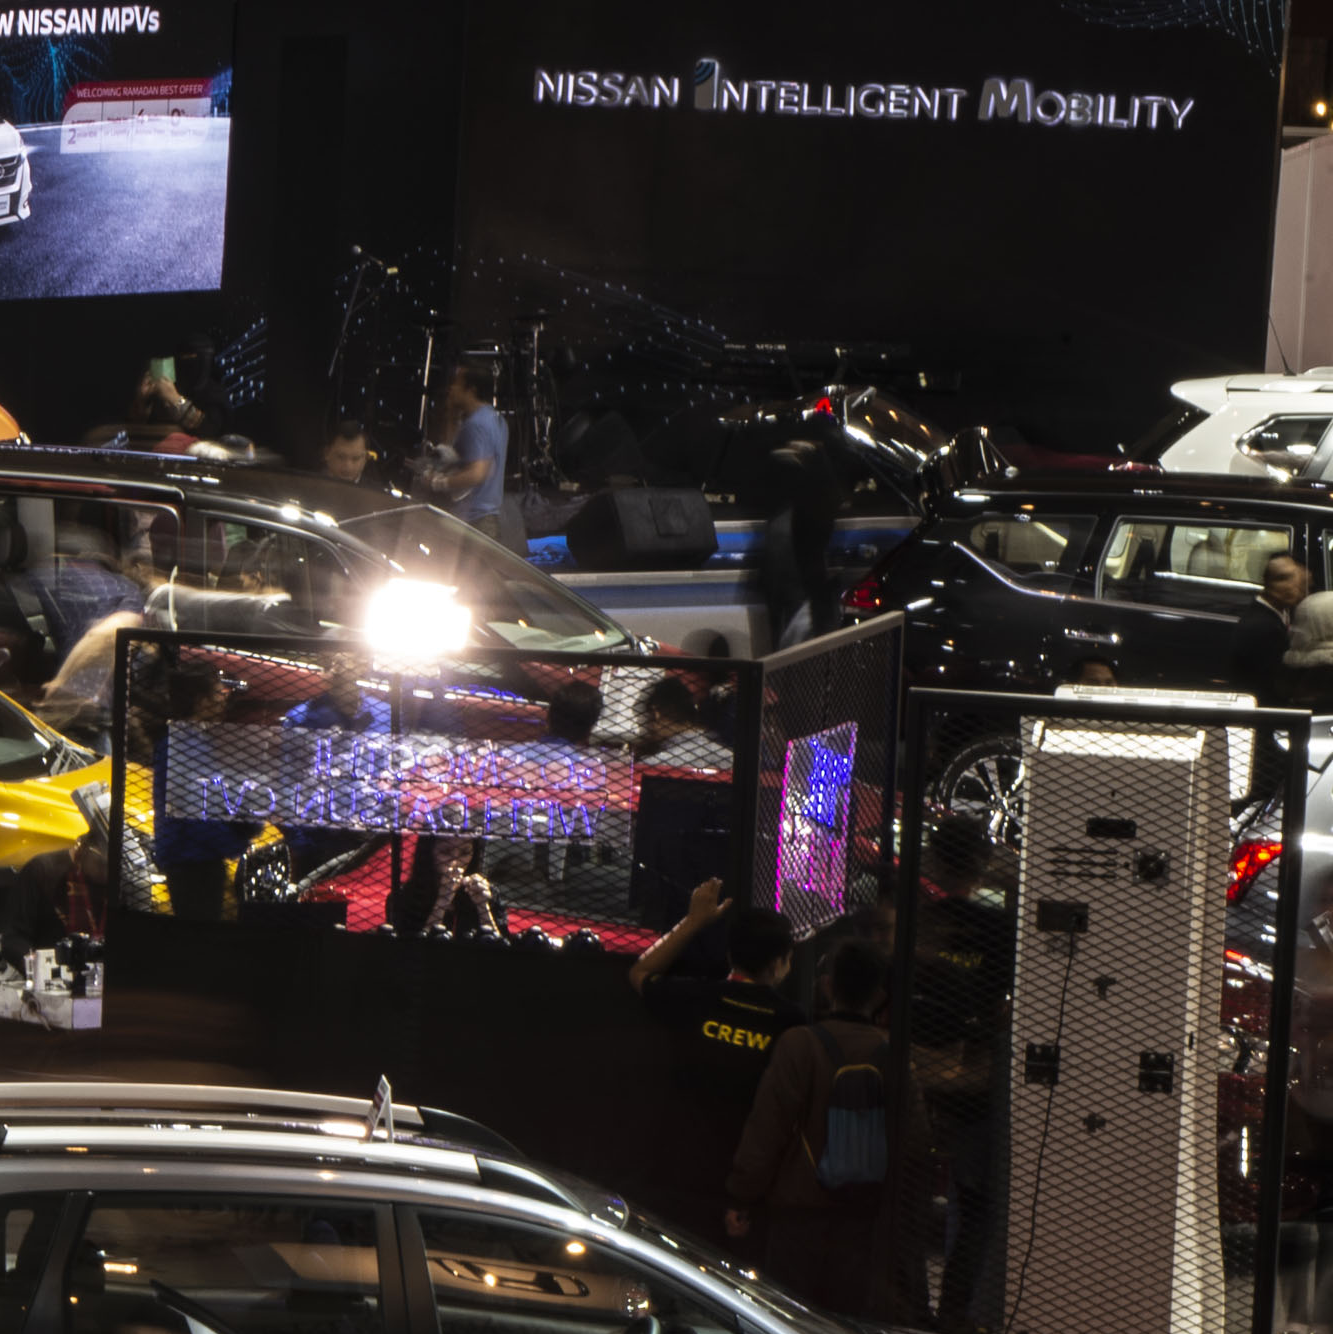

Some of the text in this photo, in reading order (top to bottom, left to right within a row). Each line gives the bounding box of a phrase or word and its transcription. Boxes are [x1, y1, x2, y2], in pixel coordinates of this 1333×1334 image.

[18, 8, 97, 37] NISSAN
[101, 6, 160, 34] MPVs
[76, 83, 203, 99] WELCOMING RAMADAN BEST OFFER
[534, 67, 679, 107] NISSAN
[978, 77, 1194, 130] MOBILITY
[702, 1020, 772, 1051] CREW
